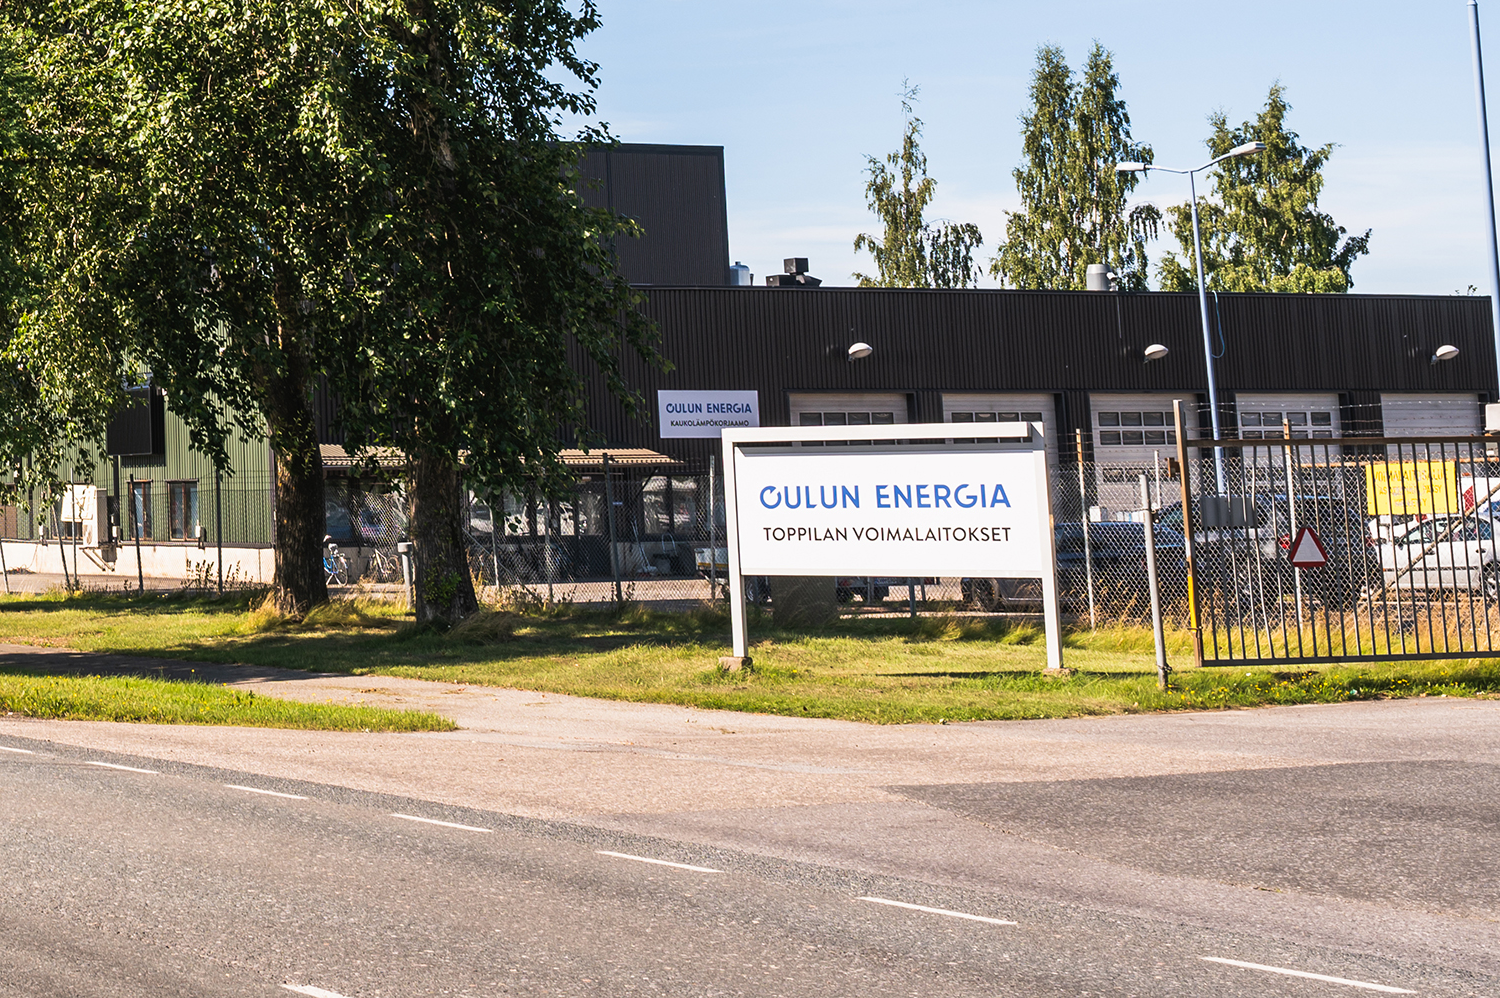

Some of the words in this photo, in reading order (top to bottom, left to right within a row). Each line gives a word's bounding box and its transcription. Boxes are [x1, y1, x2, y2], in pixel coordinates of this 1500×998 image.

[666, 403, 702, 413] OULUN
[706, 403, 752, 413] ENERGIA
[670, 418, 750, 427] KAUKOLÄMPÖKORJAAMO
[759, 484, 860, 510] OULUN
[875, 483, 1012, 509] ENERGIA
[763, 527, 848, 542] TOPPILAN
[852, 526, 1011, 542] VOIMALAITOKSET
